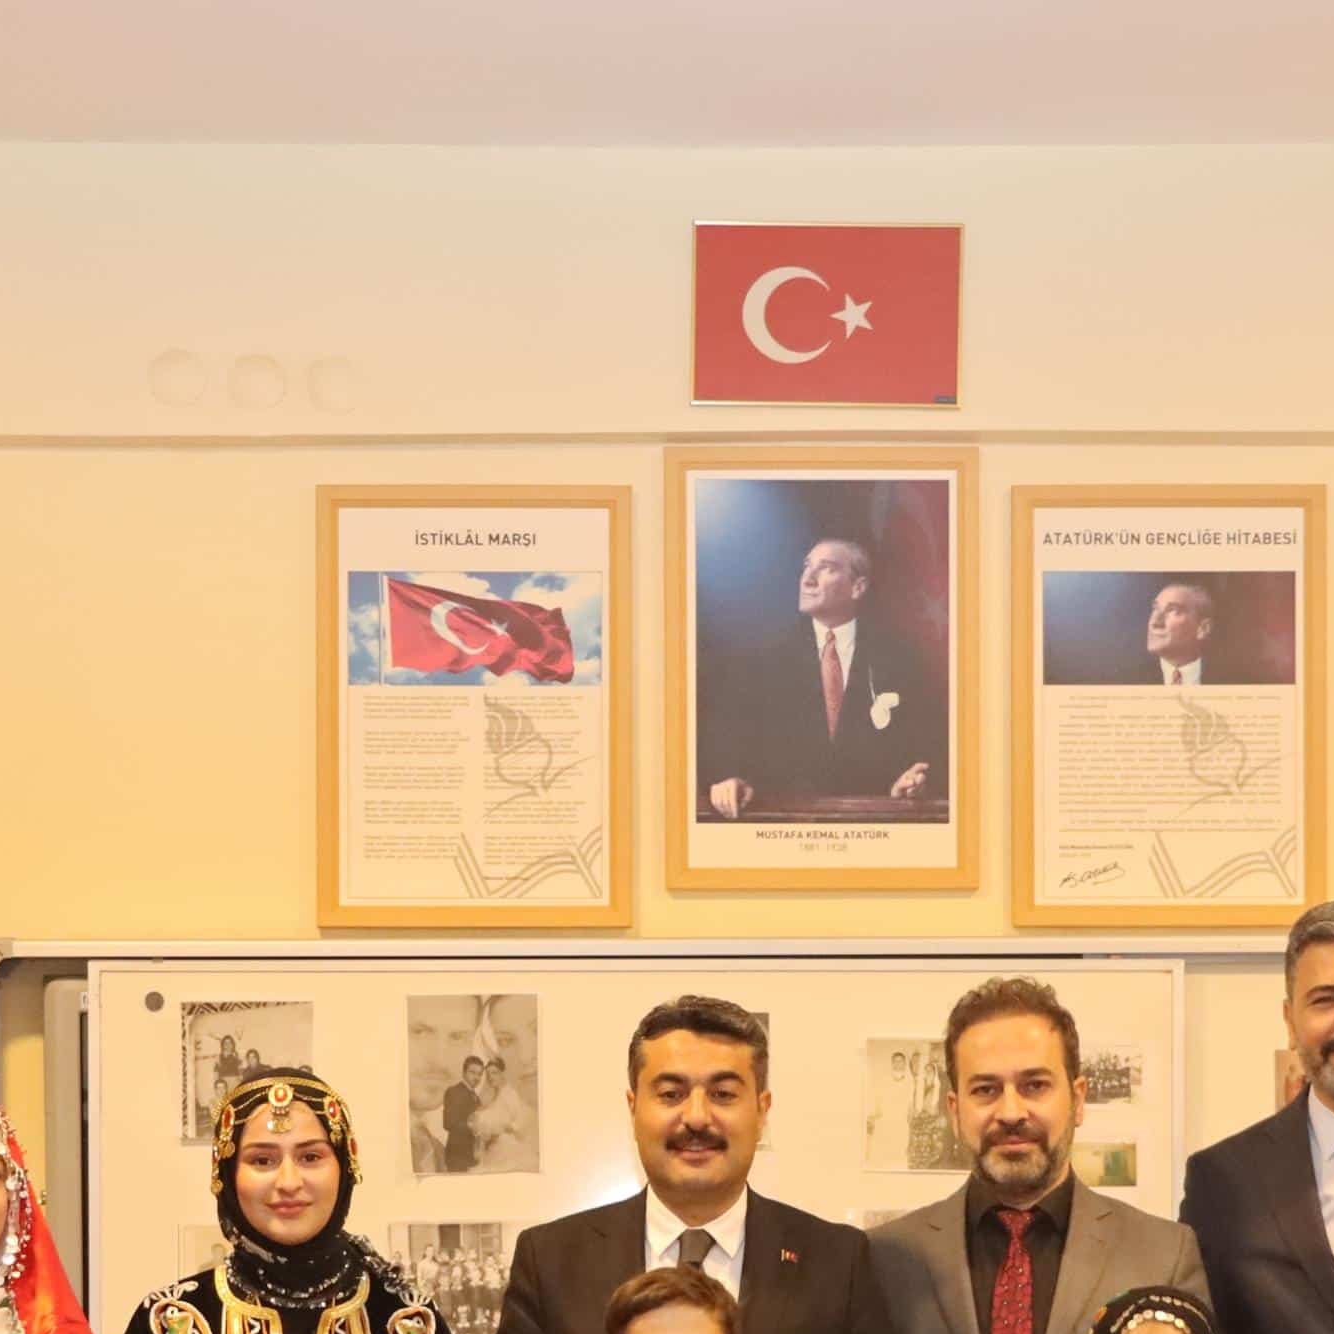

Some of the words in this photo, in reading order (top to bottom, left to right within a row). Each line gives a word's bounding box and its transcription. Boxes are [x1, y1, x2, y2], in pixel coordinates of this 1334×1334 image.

[414, 529, 483, 546] İSTİKLÂL
[488, 532, 537, 548] MARŞI
[1042, 529, 1141, 546] ATATÜRK'ÜN
[1144, 529, 1222, 547] GENÇLİĞE
[1225, 529, 1298, 546] HİTABESİ
[756, 830, 804, 840] MUSTAFA
[806, 830, 841, 840] KEMAL
